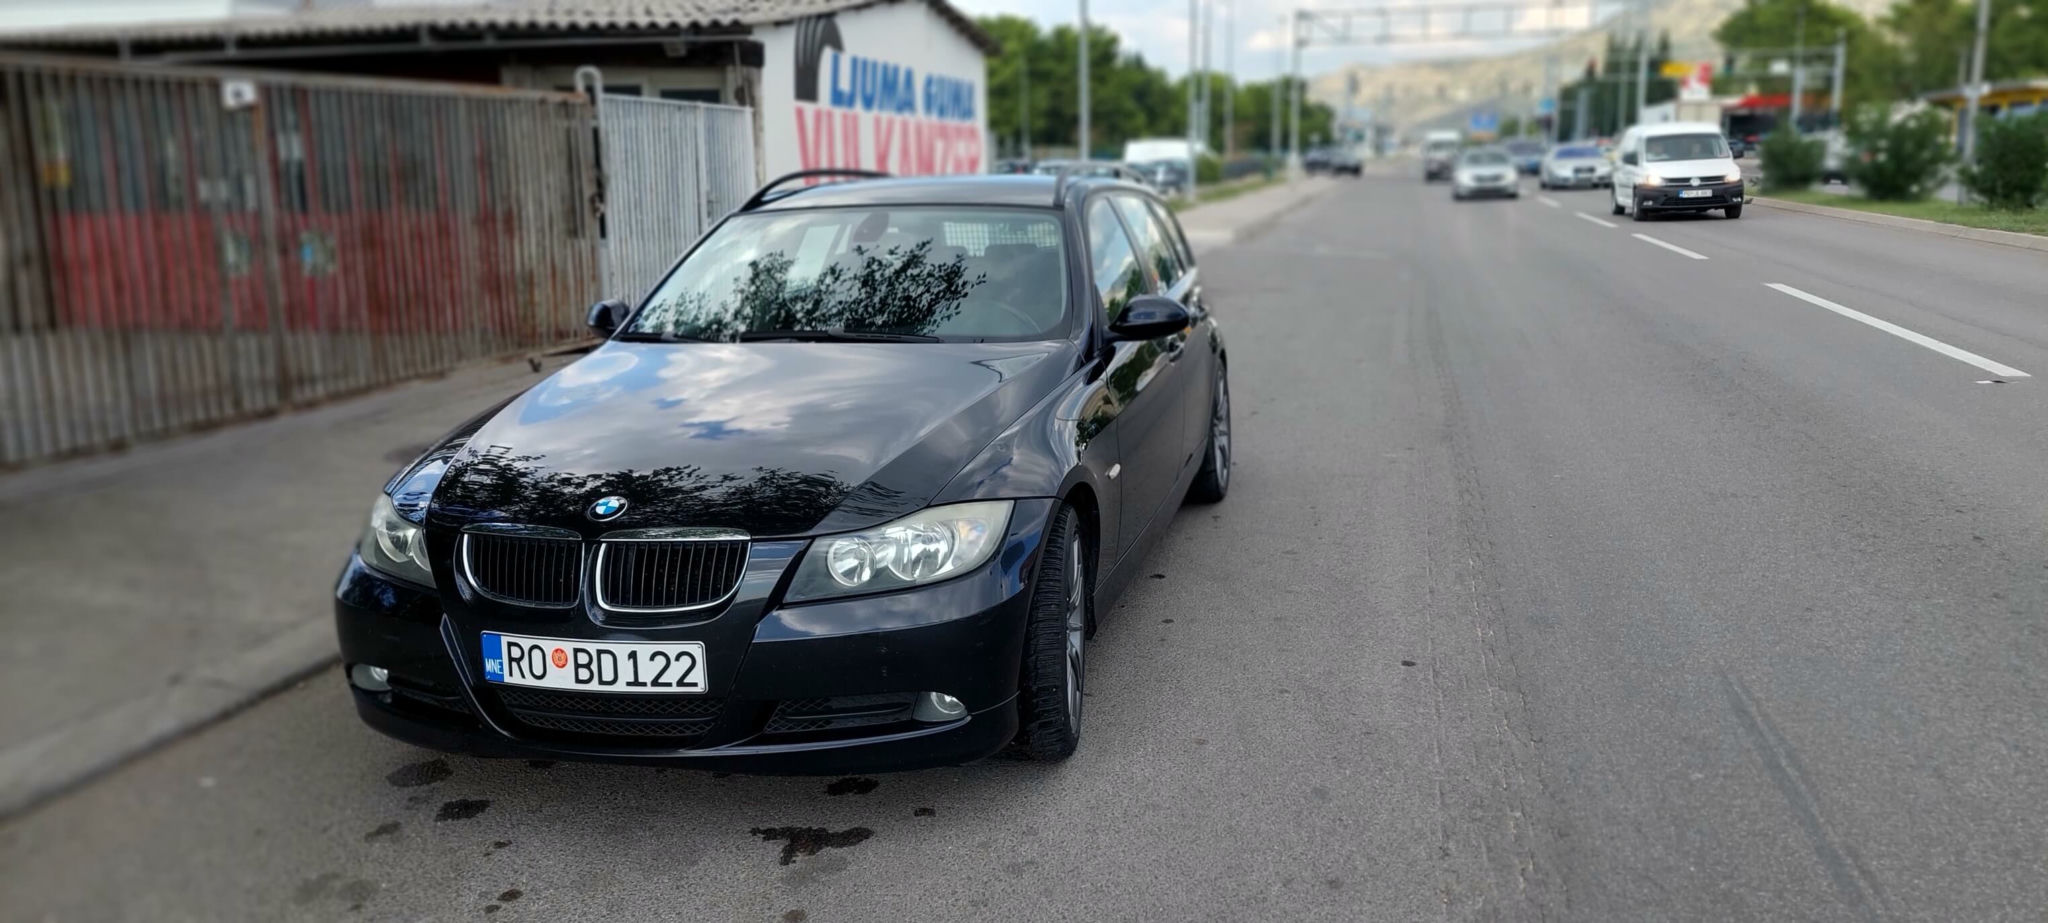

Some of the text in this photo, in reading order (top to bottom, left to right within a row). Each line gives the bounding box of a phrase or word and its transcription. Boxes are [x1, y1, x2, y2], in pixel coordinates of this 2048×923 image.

[485, 658, 504, 675] MNE
[506, 640, 699, 688] RO BD122
